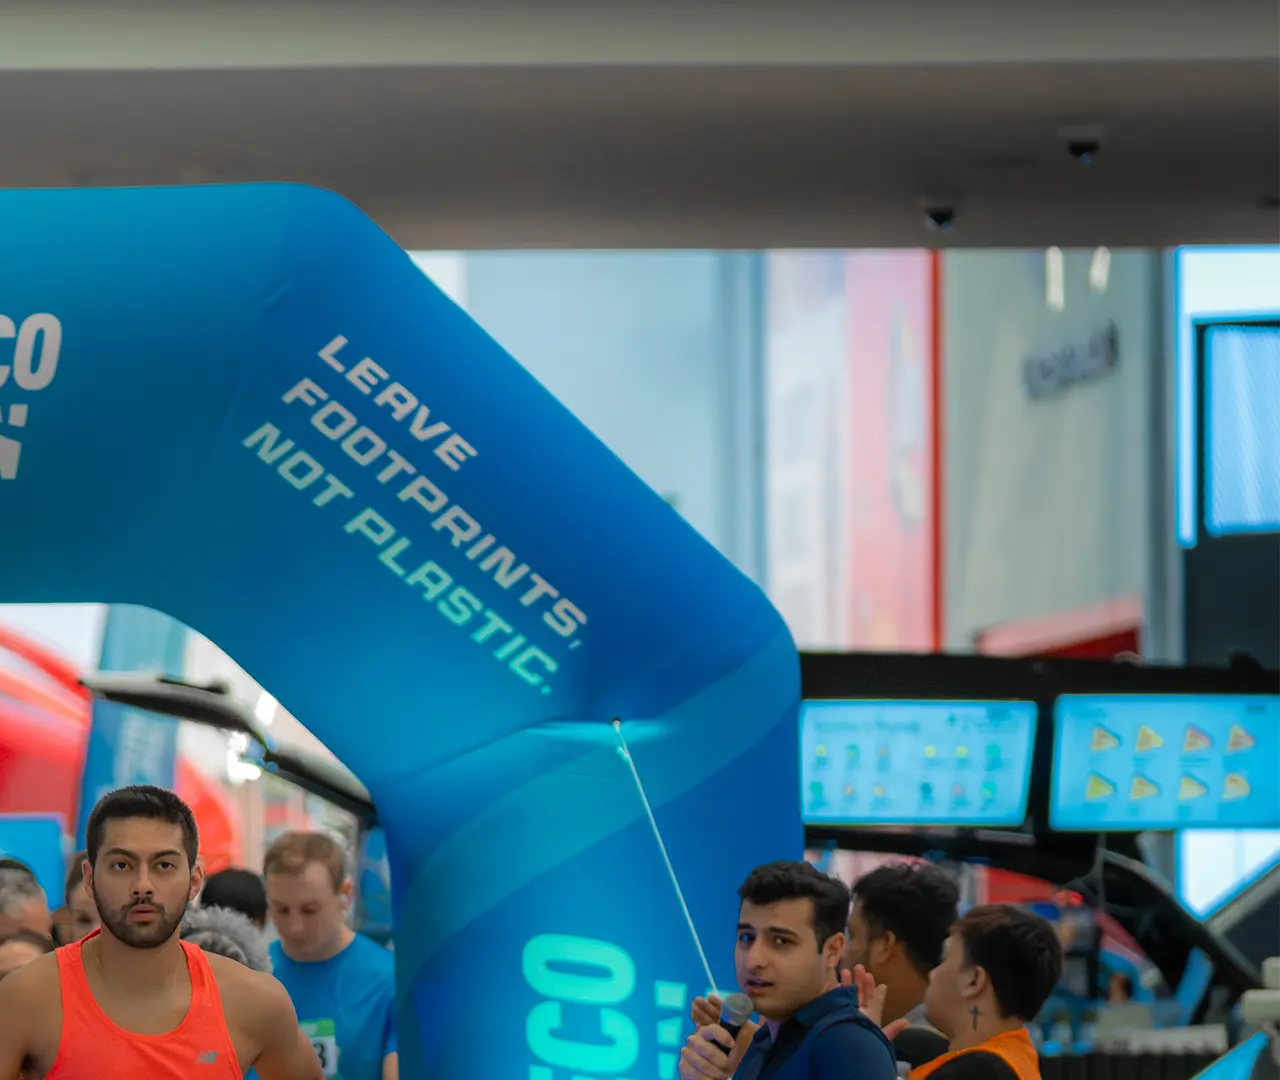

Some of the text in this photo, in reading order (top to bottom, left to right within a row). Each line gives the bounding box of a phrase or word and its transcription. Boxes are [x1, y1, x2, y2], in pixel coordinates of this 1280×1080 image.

[282, 377, 588, 650] FOOTPRINTS,
[317, 334, 478, 472] LEAVE
[242, 421, 558, 696] NOT PLASTIC.
